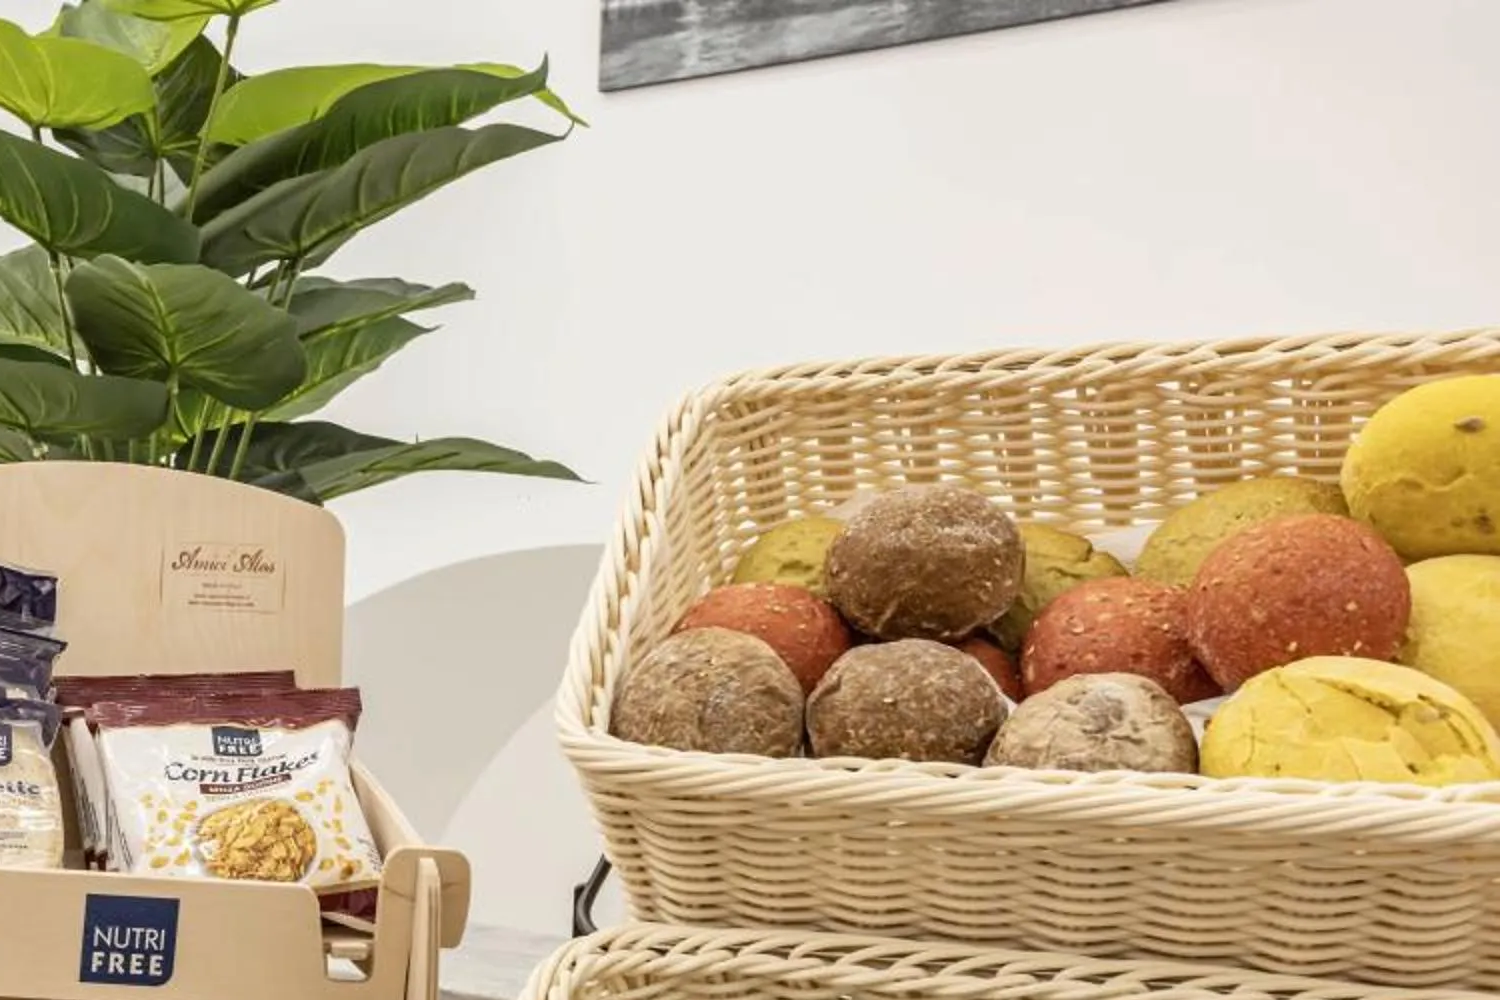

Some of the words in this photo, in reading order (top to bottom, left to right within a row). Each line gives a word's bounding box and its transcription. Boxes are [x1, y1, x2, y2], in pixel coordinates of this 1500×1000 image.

[165, 762, 231, 783] Corn
[236, 751, 319, 783] Flakes
[93, 926, 166, 951] NUTRI
[91, 951, 164, 977] FREE
